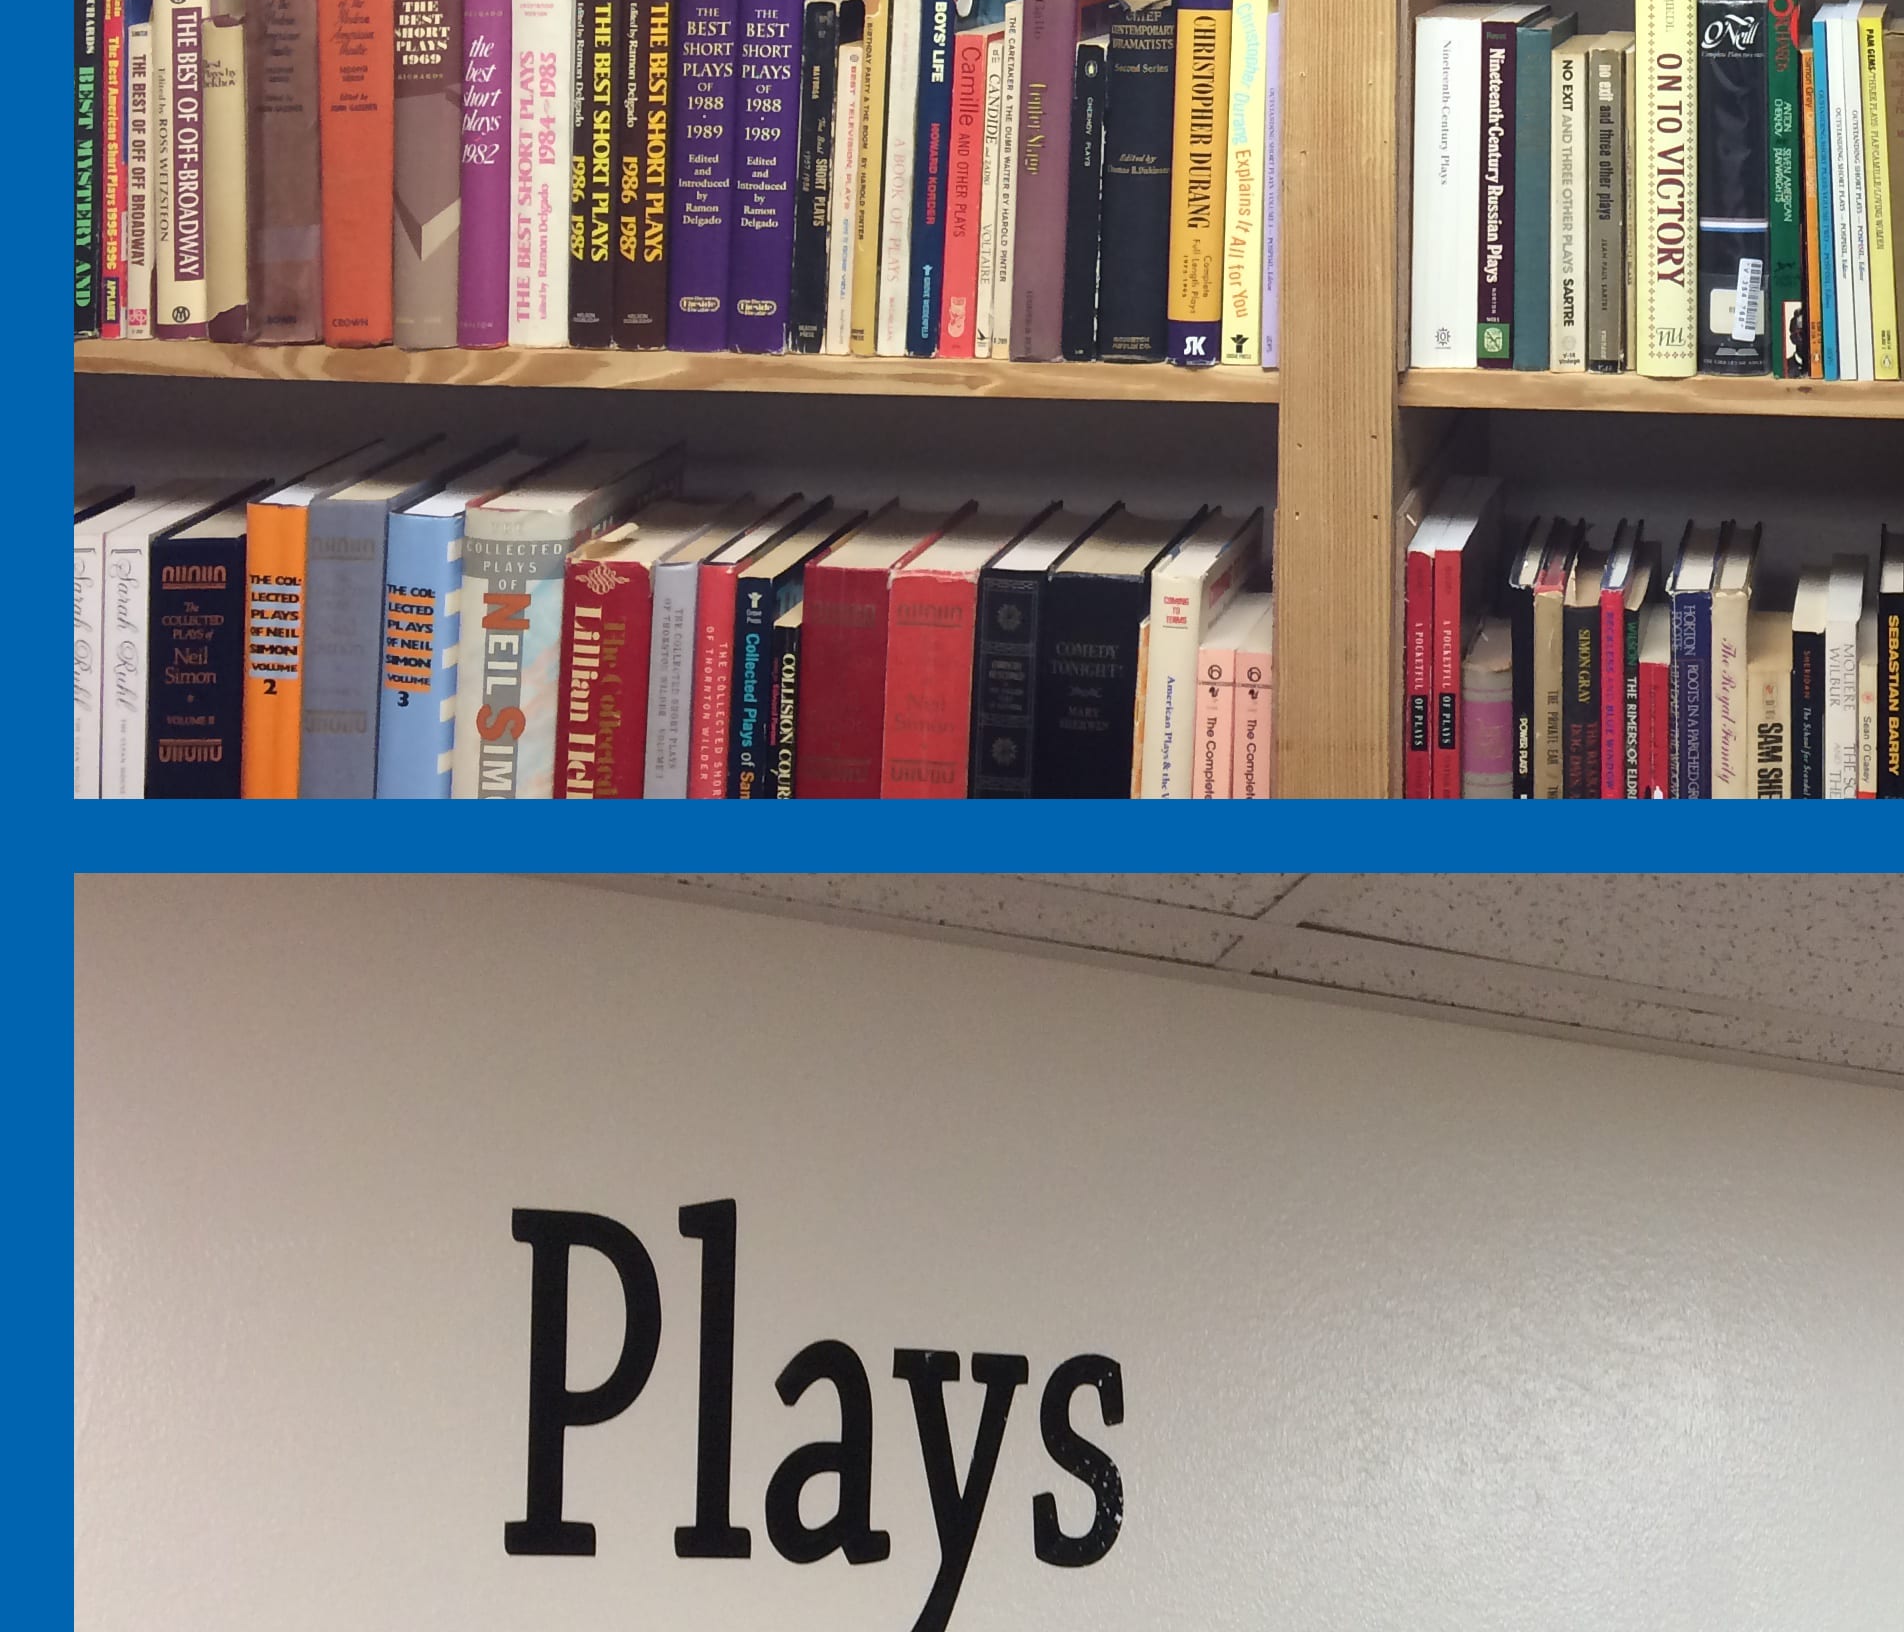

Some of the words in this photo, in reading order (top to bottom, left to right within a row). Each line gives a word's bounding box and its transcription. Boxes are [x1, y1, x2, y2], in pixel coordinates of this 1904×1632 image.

[697, 8, 719, 17] THE
[176, 12, 197, 47] THE
[687, 21, 731, 36] BEST
[684, 42, 733, 58] SHORT
[177, 52, 198, 91] BEST
[684, 62, 733, 78] PLAYS
[1657, 54, 1682, 91] ON
[698, 83, 713, 91] OF
[1190, 16, 1216, 146] CHRISTOPHER
[178, 98, 198, 122] OF
[688, 96, 723, 111] 1988
[1657, 100, 1683, 133] TO
[686, 125, 722, 139] 1989
[1188, 152, 1212, 229] DURANG
[178, 128, 200, 276] OFF-BROADWAY
[1657, 144, 1684, 288] VICTORY
[467, 544, 561, 556] COLLECTED
[483, 561, 536, 573] PLAYS
[499, 579, 516, 590] OF
[481, 594, 531, 695] NEIL
